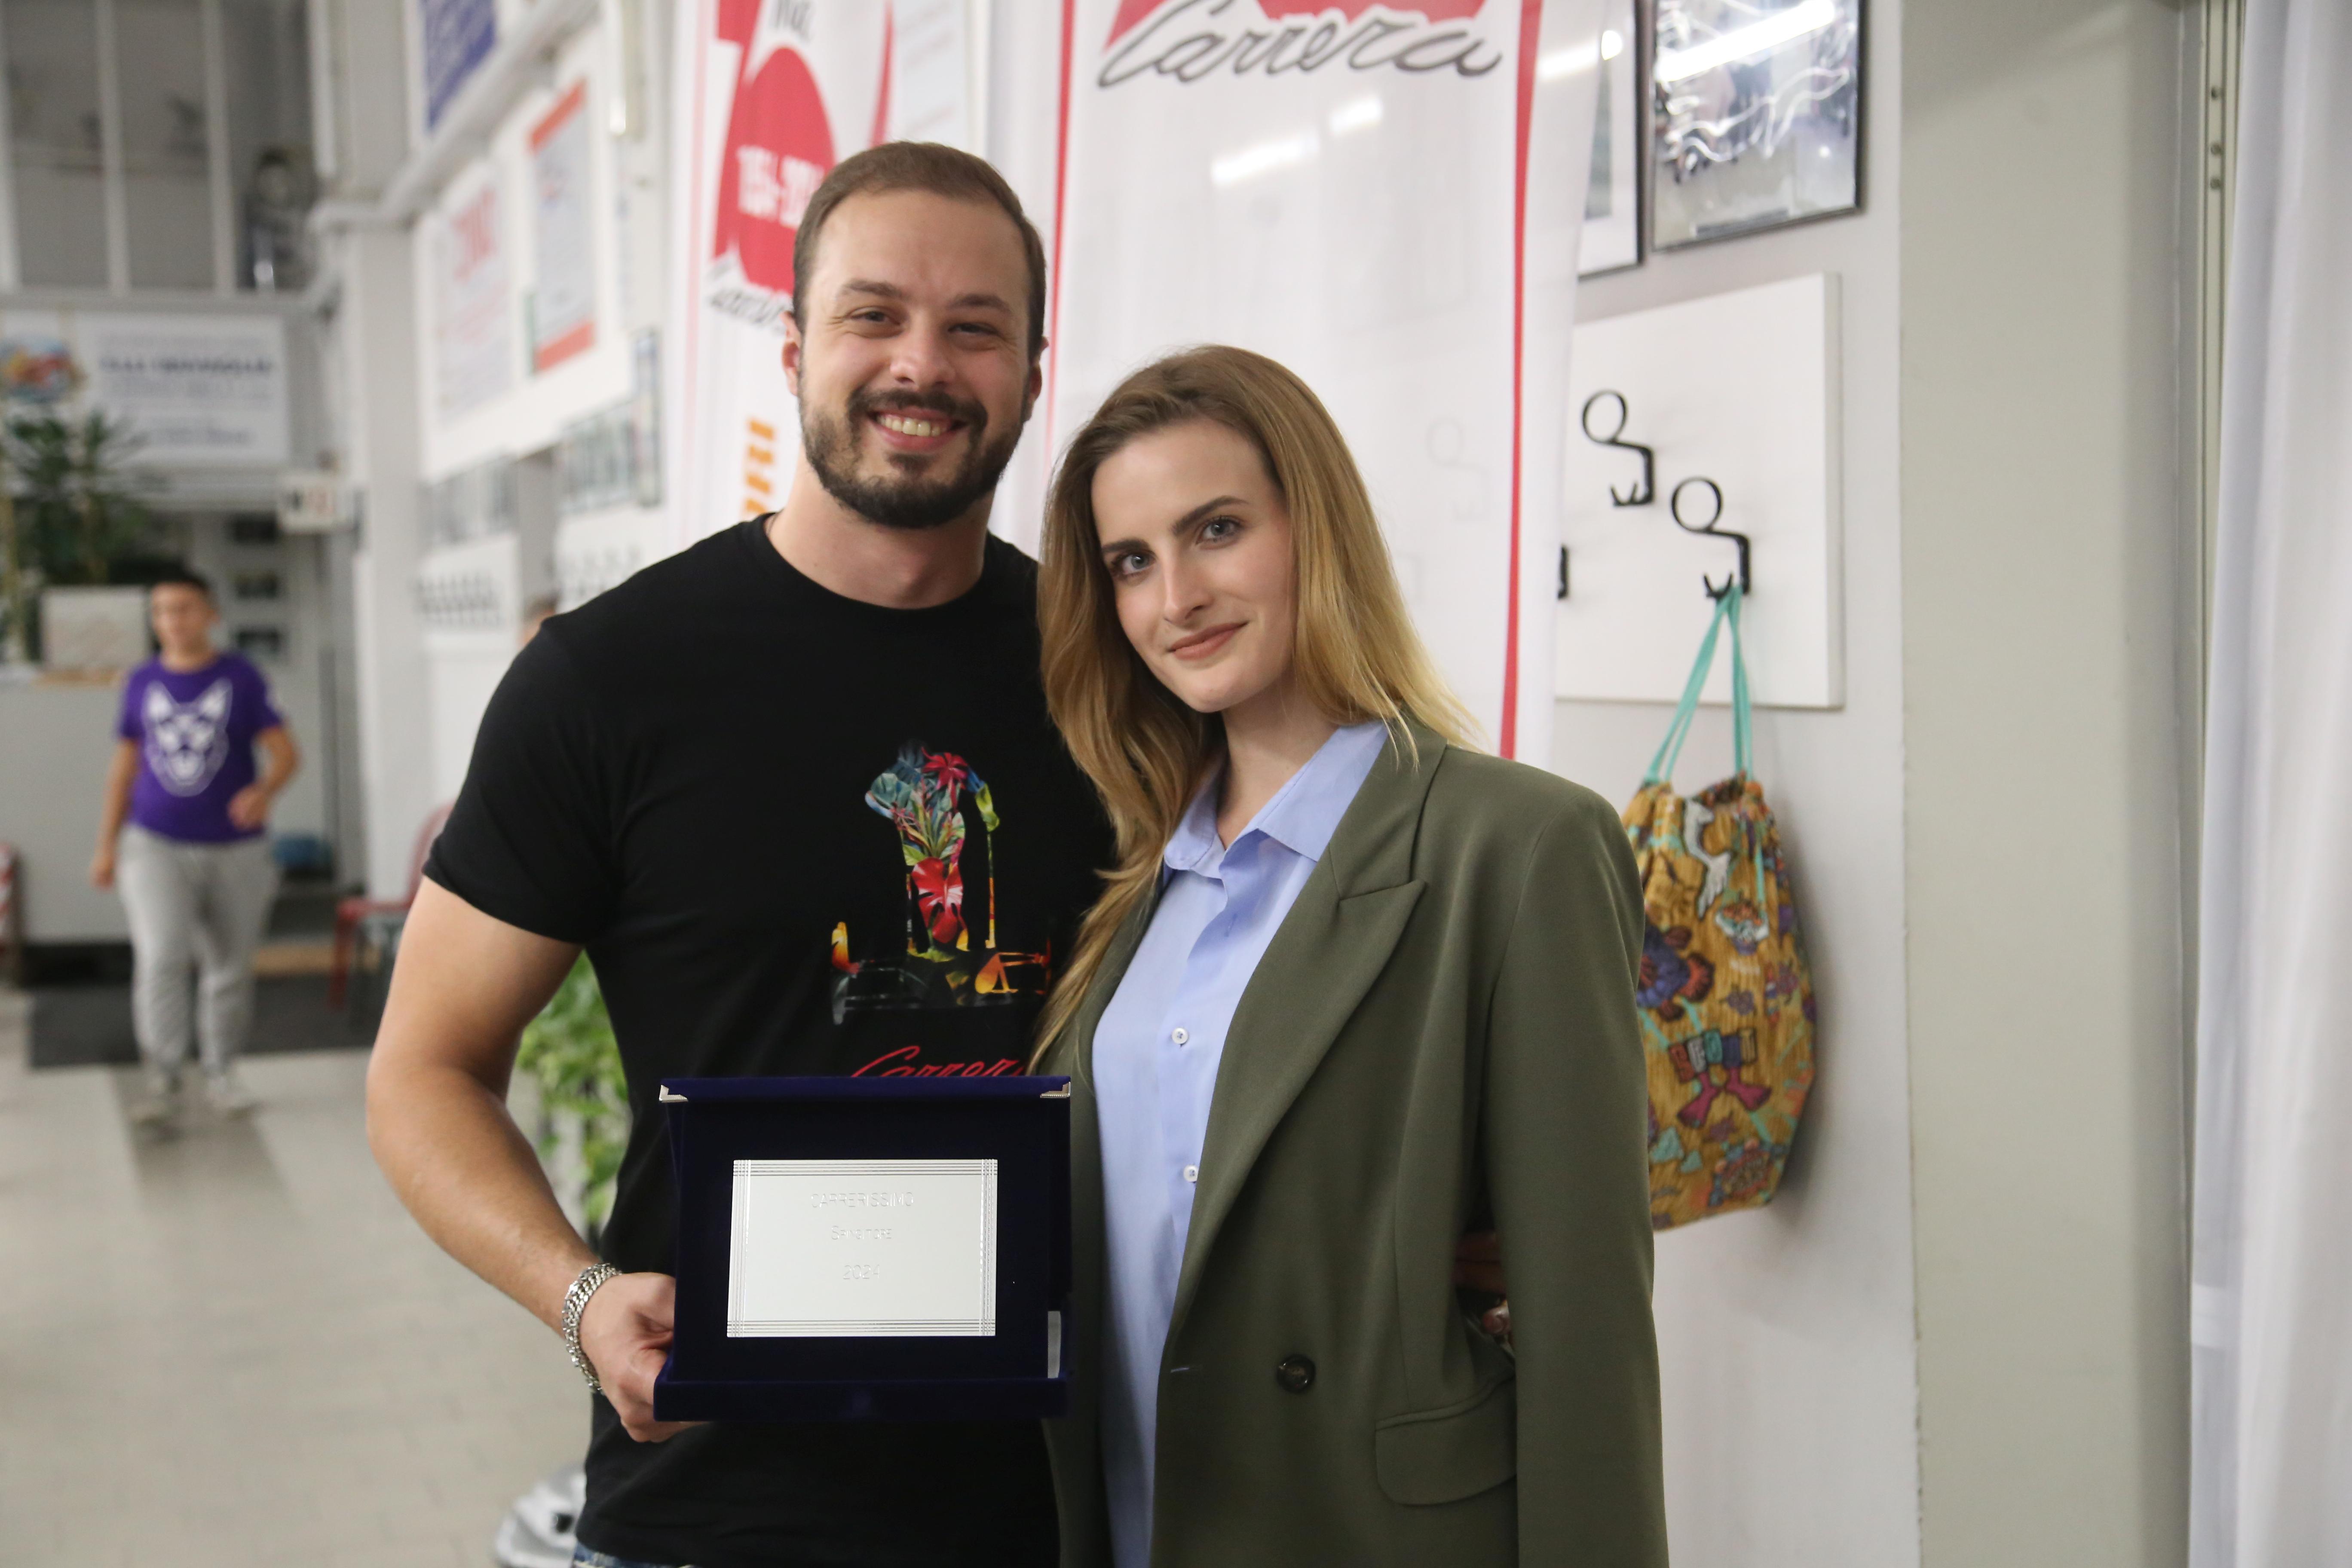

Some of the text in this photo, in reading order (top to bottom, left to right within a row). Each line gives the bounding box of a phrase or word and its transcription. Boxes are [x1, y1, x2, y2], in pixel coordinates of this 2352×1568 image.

[1096, 0, 1503, 88] Carrera
[851, 1045, 1026, 1078] Carrer
[811, 1191, 914, 1208] CARRERISSIMO
[842, 1264, 880, 1280] 2024
